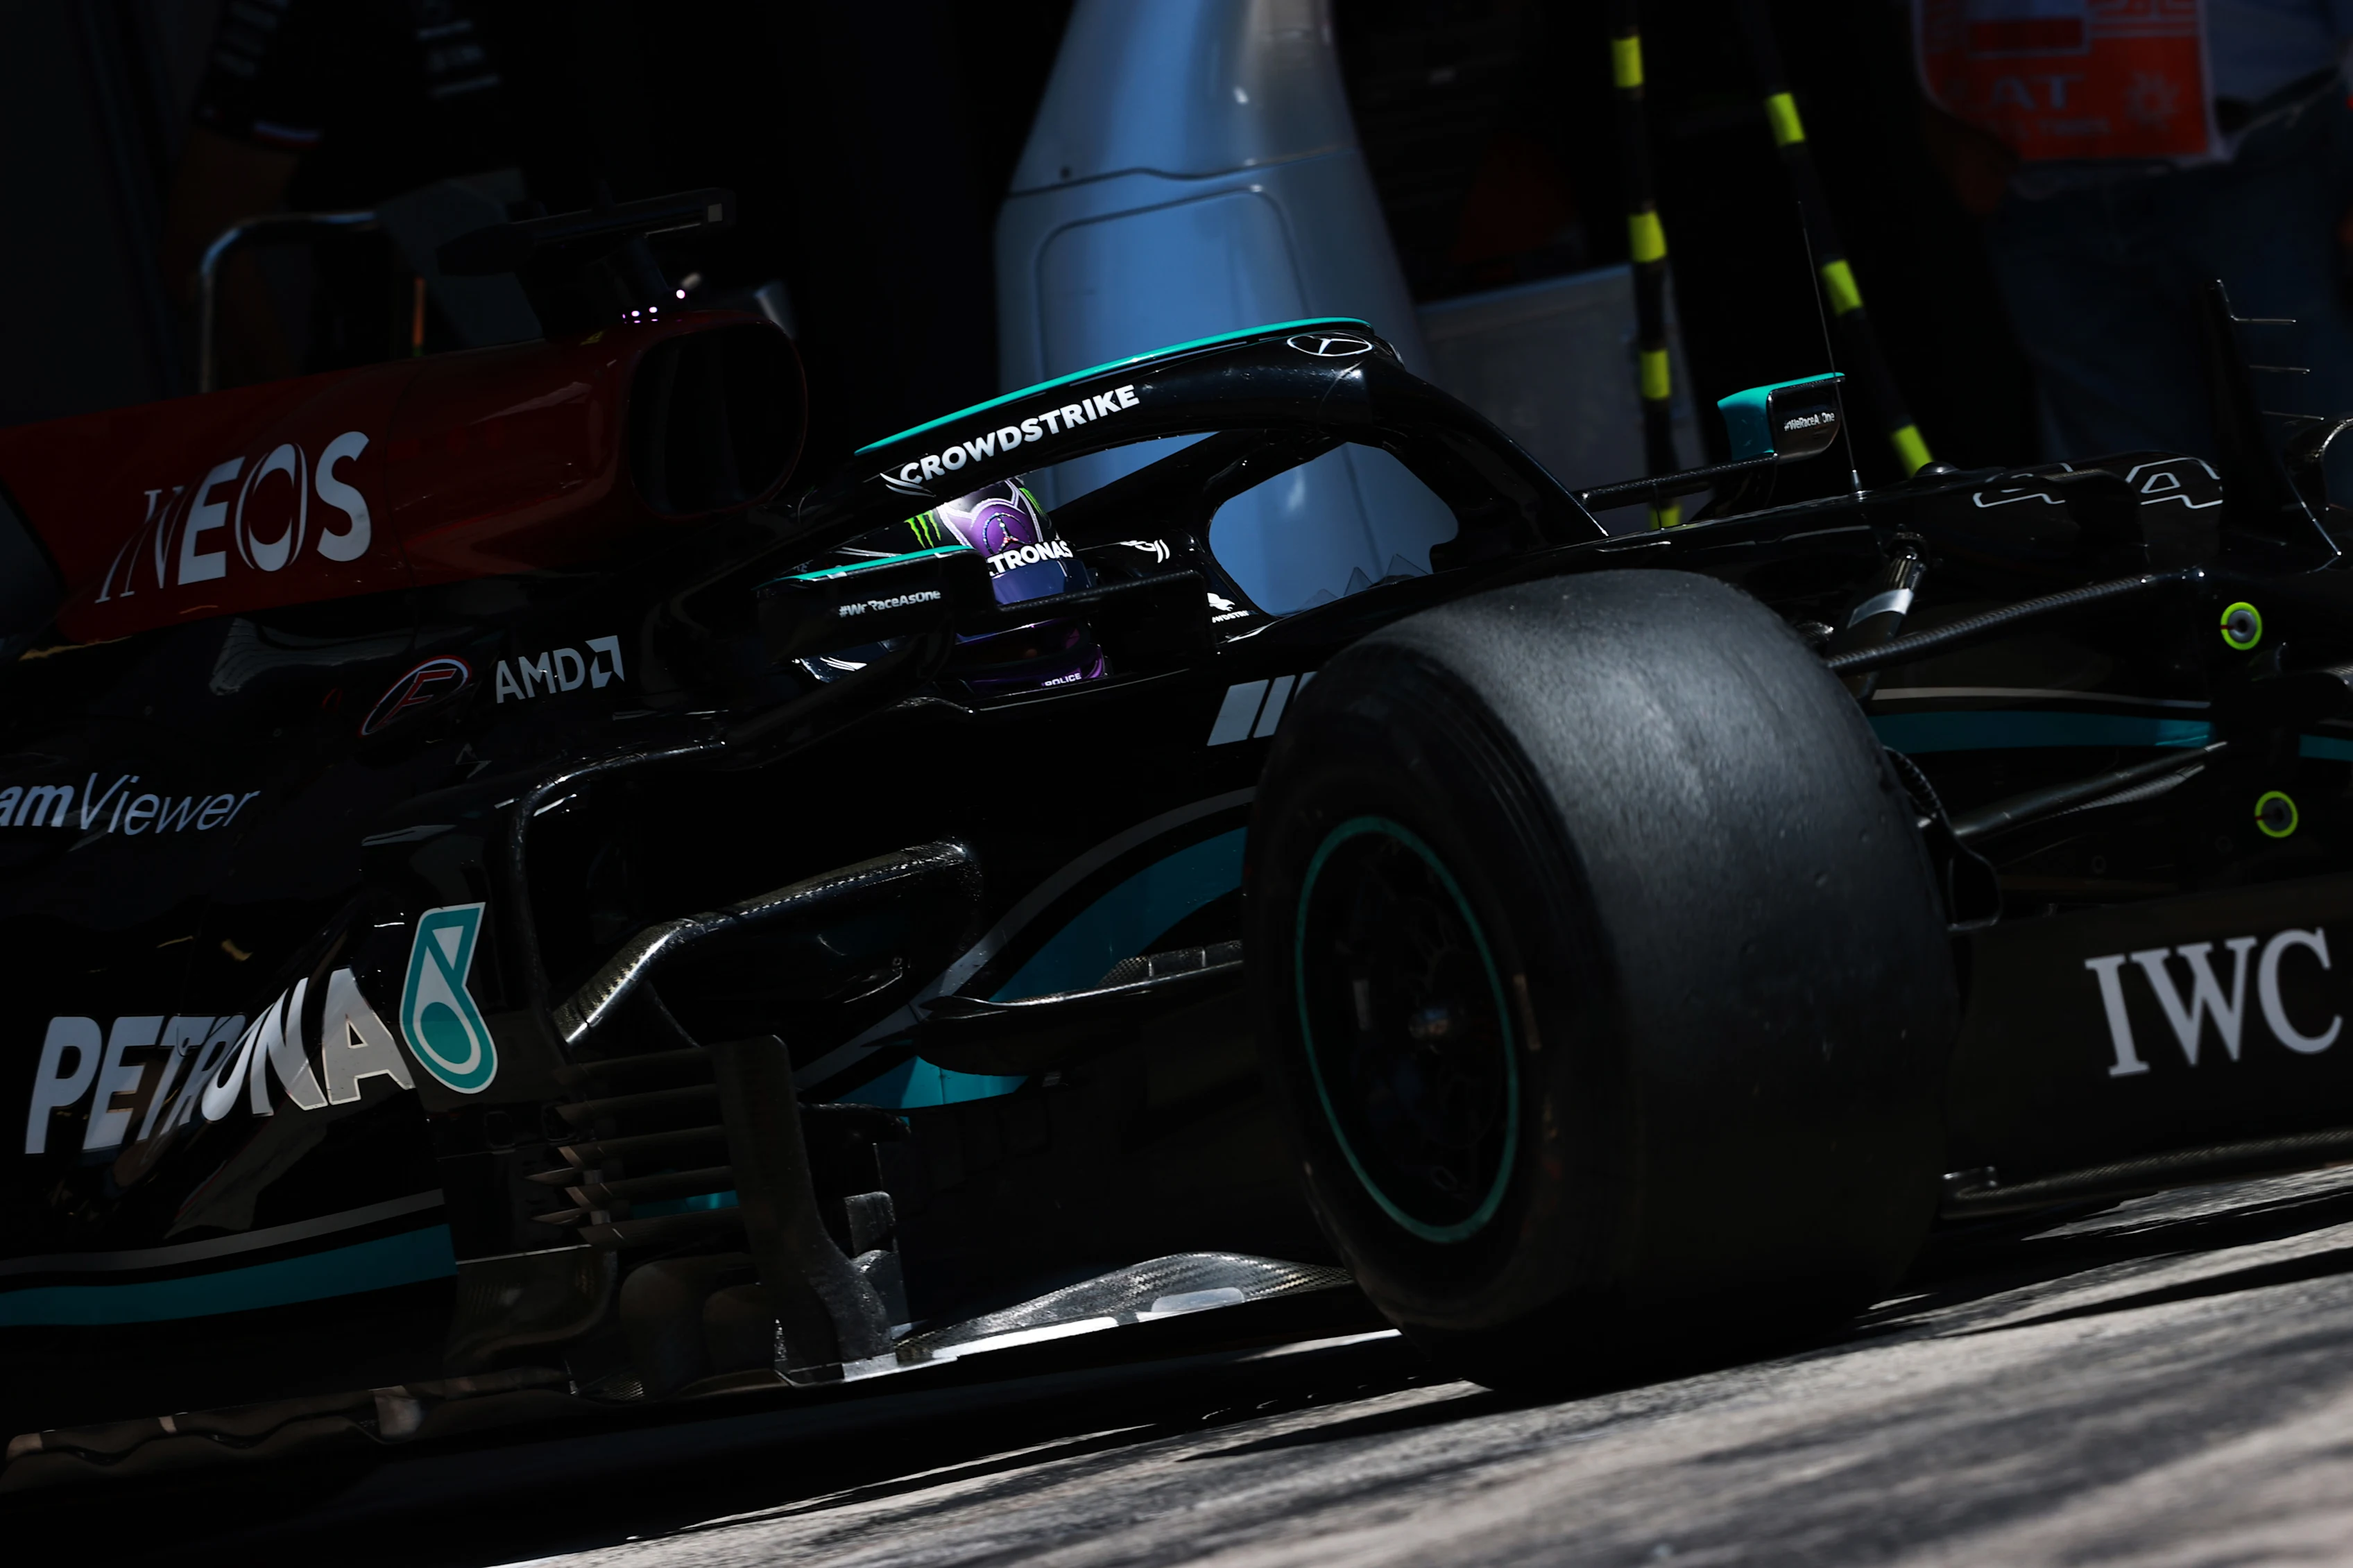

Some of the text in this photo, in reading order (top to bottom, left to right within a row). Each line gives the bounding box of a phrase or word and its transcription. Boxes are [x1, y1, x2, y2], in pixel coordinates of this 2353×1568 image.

[900, 384, 1140, 484] CROWDSTRIKE
[1783, 411, 1836, 431] #WeRaceAOne
[94, 430, 373, 604] INEOS
[987, 540, 1074, 576] TRONAS
[495, 647, 586, 704] AMD
[1044, 672, 1082, 687] POLICE
[2084, 926, 2344, 1078] IWC
